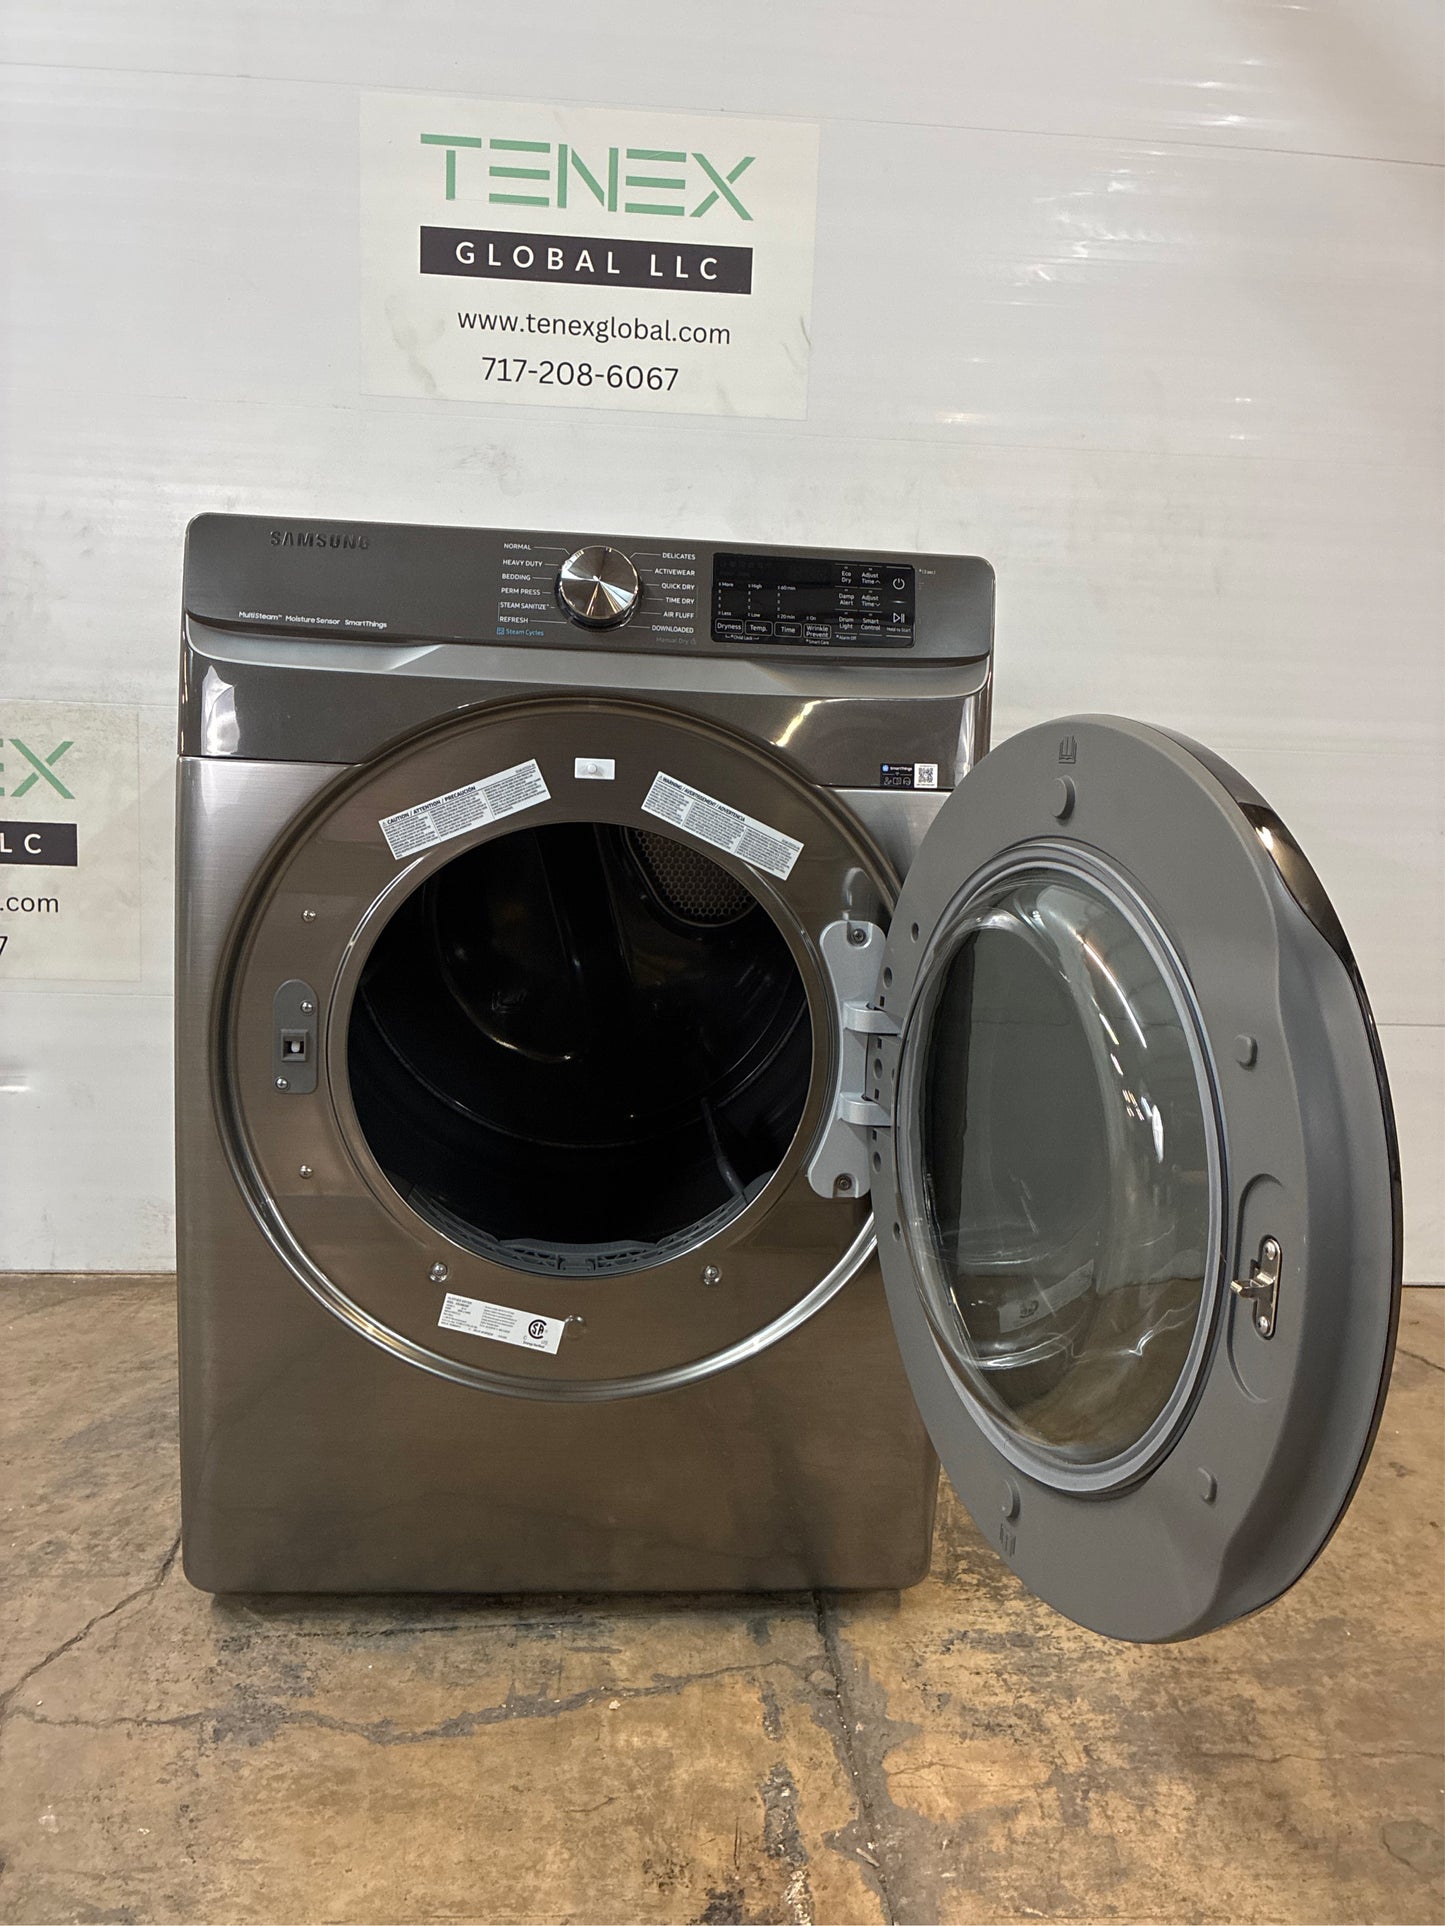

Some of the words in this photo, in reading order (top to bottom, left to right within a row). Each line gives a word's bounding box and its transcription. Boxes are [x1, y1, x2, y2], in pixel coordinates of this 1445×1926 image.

[420, 133, 756, 221] TENEX
[455, 241, 620, 275] GLOBAL
[650, 254, 718, 280] LLC
[458, 312, 731, 345] www.tenexglobal.com
[482, 356, 679, 392] 717-208-6067
[270, 530, 370, 549] SAMSUNG
[662, 552, 696, 560] DELICATES
[501, 573, 531, 581] BEDDING
[654, 568, 695, 576] ACTIVEWEAR
[500, 601, 520, 609] STEAM
[285, 615, 315, 624] Moisture
[316, 617, 340, 625] Sensor
[344, 619, 387, 630] SmartThings
[499, 616, 529, 624] REFRESH
[717, 623, 742, 631] Dryness
[651, 625, 694, 634] DOWNLOADED
[749, 624, 768, 632] Temp.
[0, 739, 75, 799] X
[387, 812, 410, 825] CAUTION
[413, 799, 441, 815] ATTENTION
[444, 785, 476, 802] PRECAUCIÓN
[662, 777, 682, 791] WARNING
[718, 805, 746, 823] ADVERTENCIA
